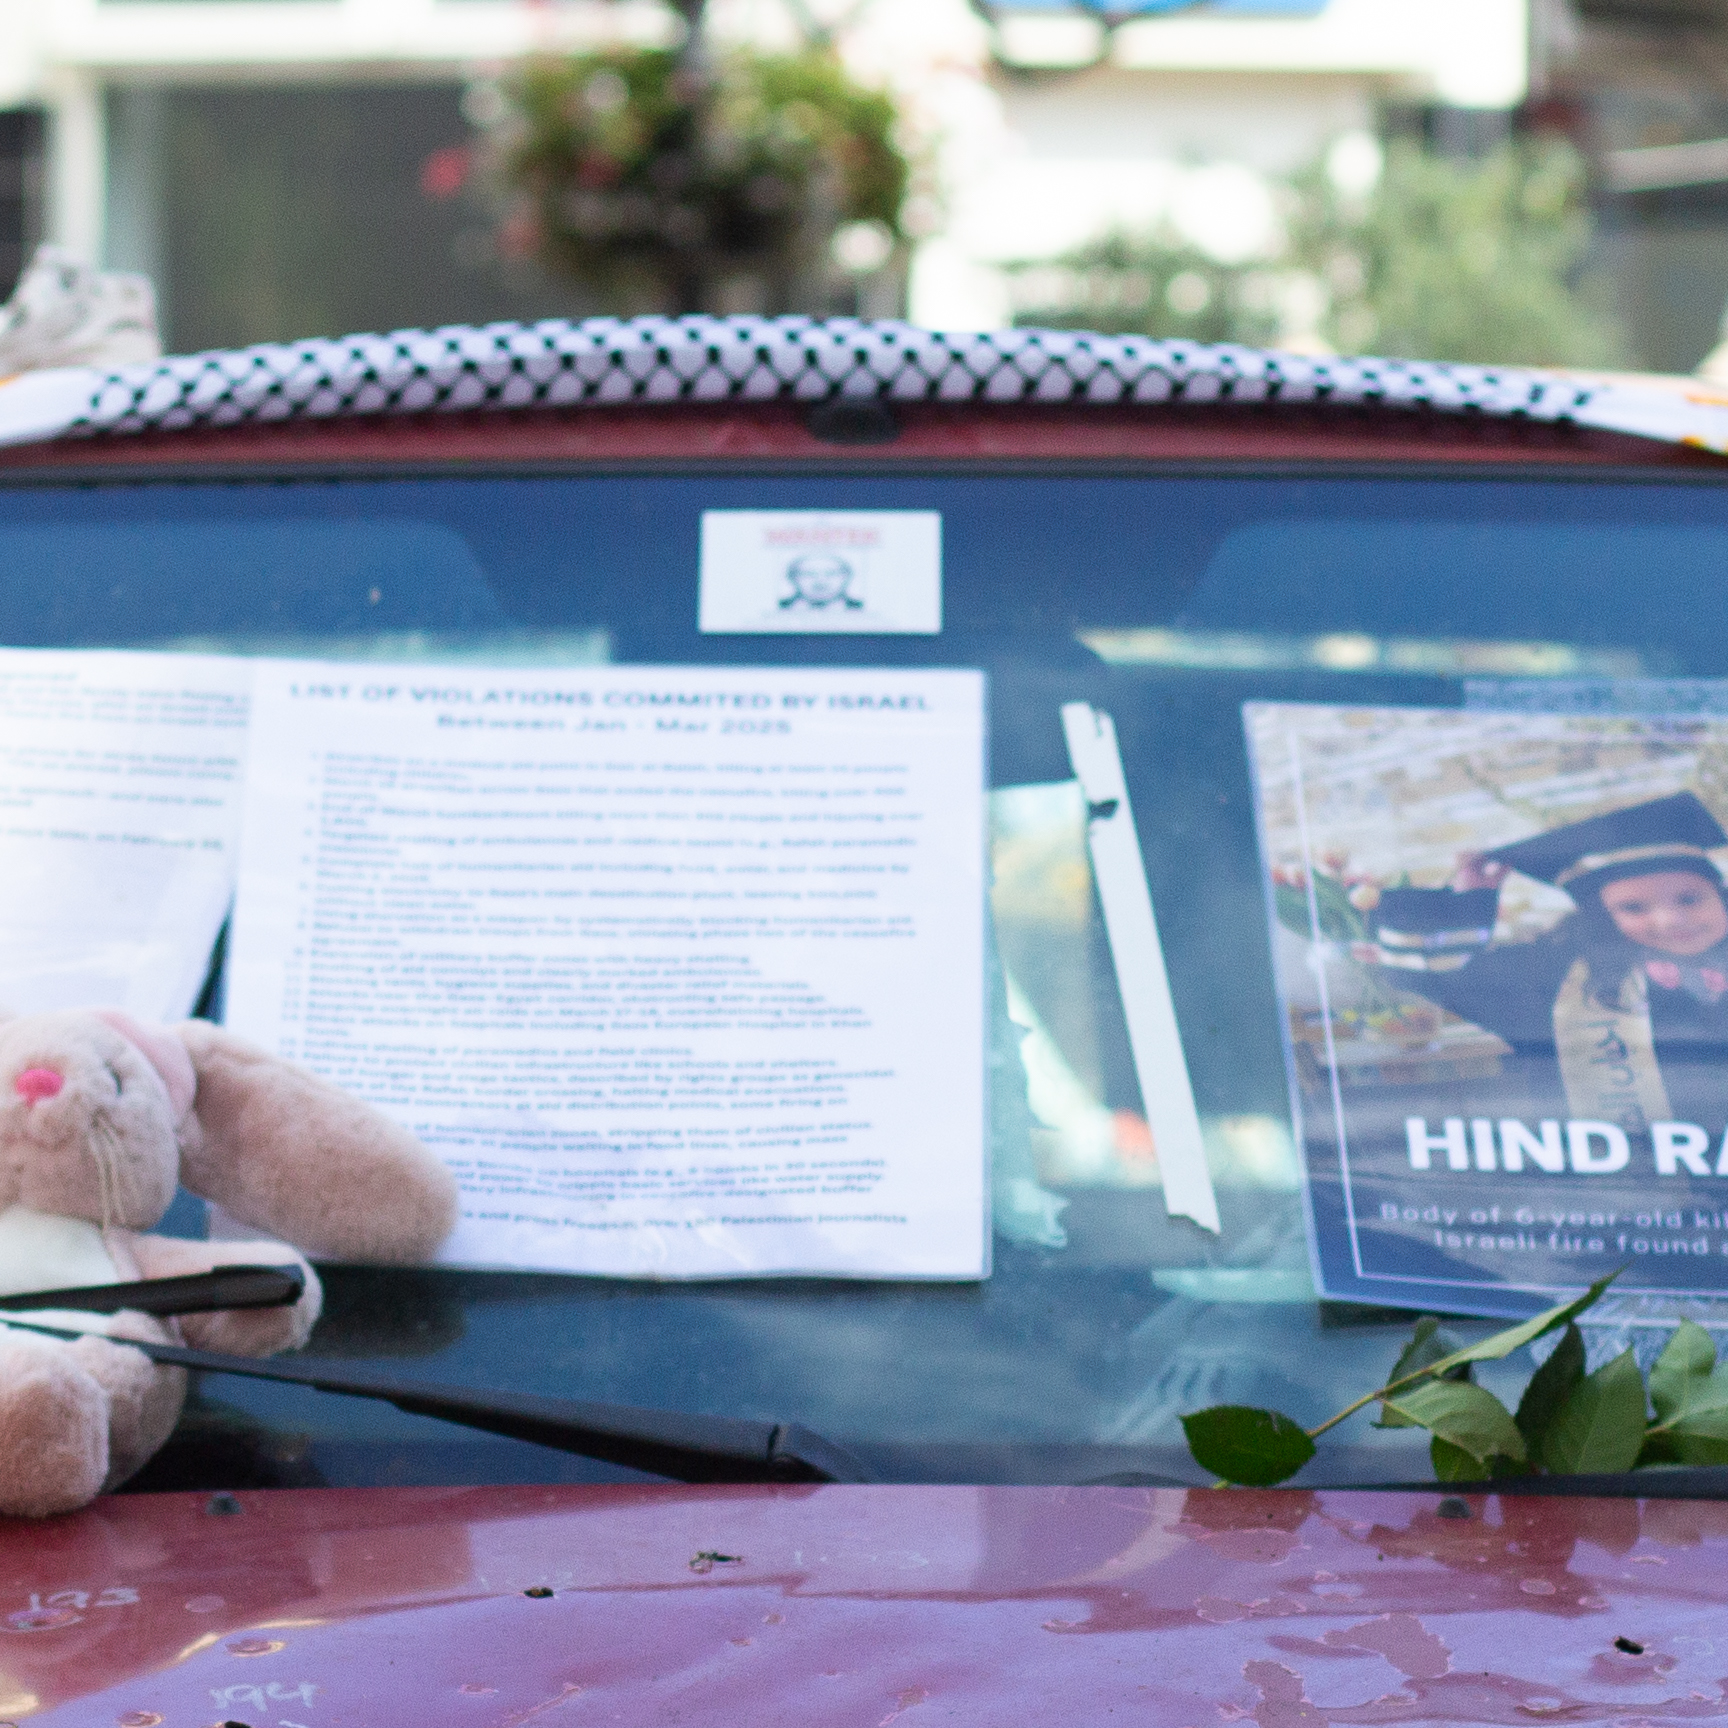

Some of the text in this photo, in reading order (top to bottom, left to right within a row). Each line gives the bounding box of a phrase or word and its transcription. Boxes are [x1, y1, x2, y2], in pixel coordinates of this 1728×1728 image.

[291, 684, 934, 712] LIST OF VIOLATIONS COMMITED BY ISRAEL
[437, 713, 567, 733] Between
[576, 716, 626, 734] Jan
[656, 717, 710, 734] Mar
[720, 717, 792, 735] 2025
[1405, 1116, 1631, 1175] HIND
[1379, 1200, 1458, 1226] Body
[1468, 1204, 1501, 1224] of
[1512, 1205, 1683, 1229] 6-year-old
[1432, 1228, 1537, 1251] Israeli
[1547, 1231, 1605, 1252] fire
[1616, 1231, 1709, 1255] found
